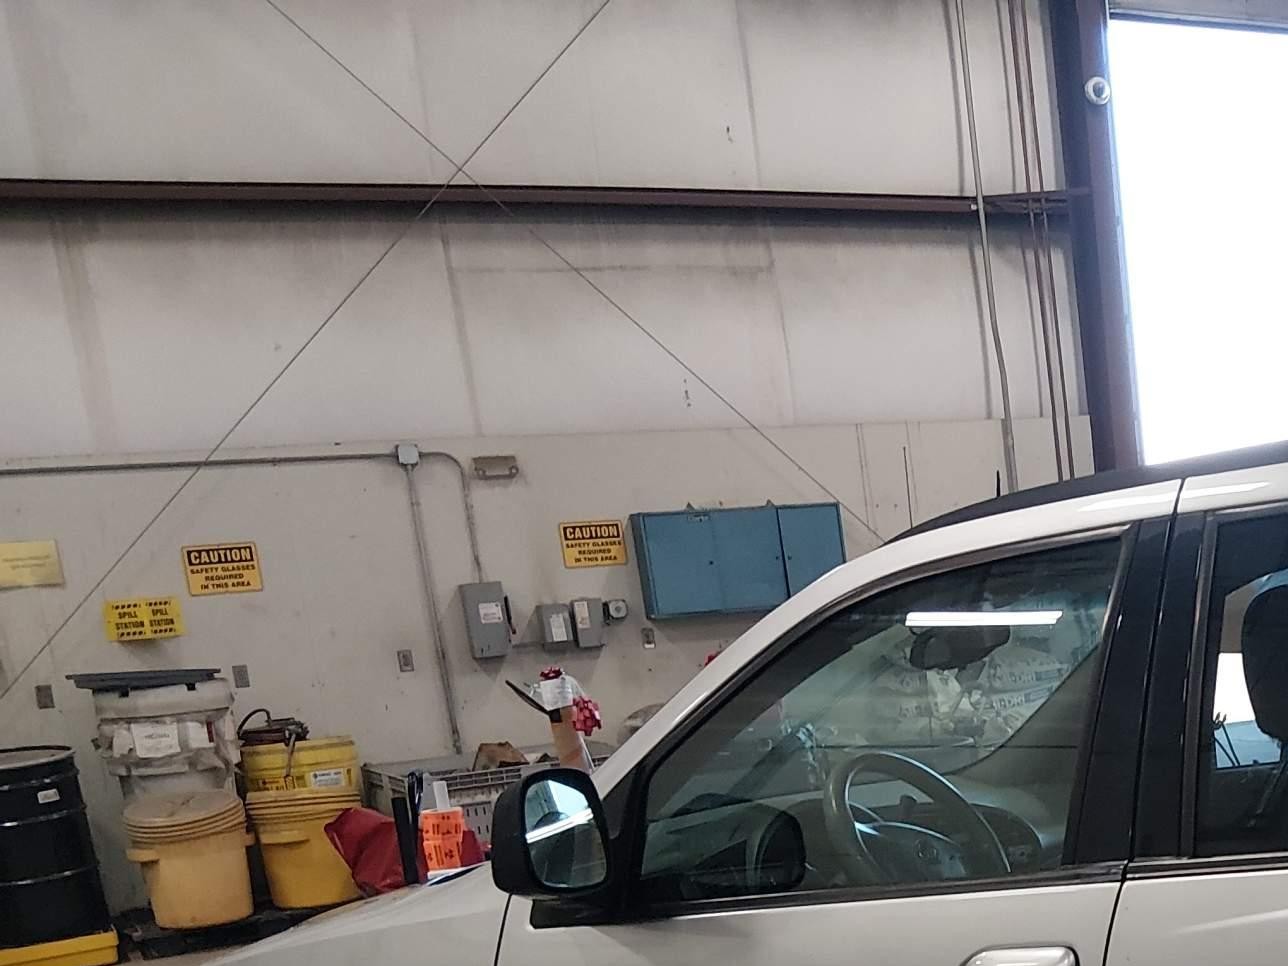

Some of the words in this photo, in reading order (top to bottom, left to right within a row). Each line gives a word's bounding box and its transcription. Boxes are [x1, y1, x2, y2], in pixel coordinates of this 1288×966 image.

[566, 526, 618, 539] CAUTION
[190, 548, 251, 564] CAUTION
[190, 566, 219, 575] SAFETY
[221, 564, 256, 573] GLASSES
[204, 573, 245, 582] REQUIRED
[212, 582, 229, 590] THIS
[231, 580, 252, 588] AREA
[117, 611, 138, 620] SPILL
[151, 608, 169, 617] SPILL
[115, 620, 145, 631] STATION
[149, 617, 175, 627] STATION
